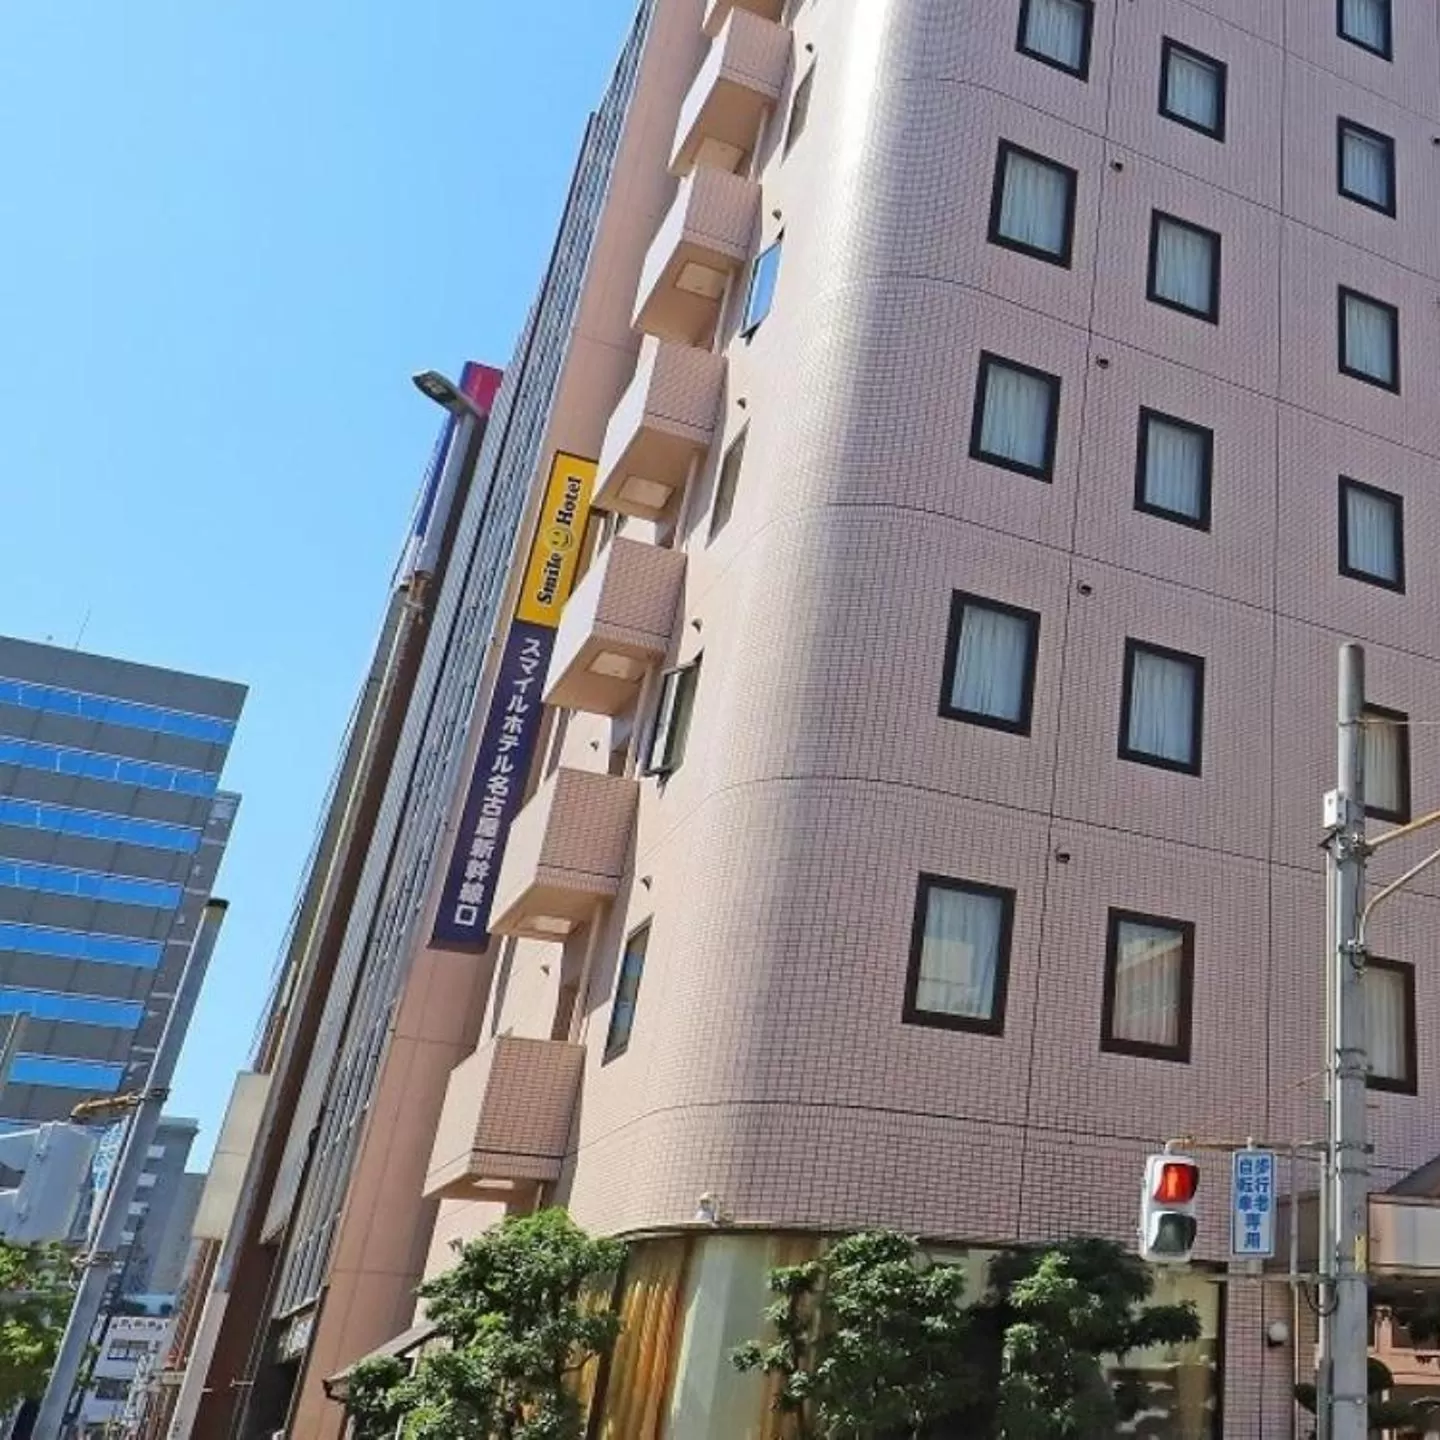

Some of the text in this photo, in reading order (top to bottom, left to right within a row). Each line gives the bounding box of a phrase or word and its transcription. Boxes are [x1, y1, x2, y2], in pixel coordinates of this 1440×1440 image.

[537, 476, 582, 606] Smile Hotel
[454, 637, 541, 927] スマイルホテル名古屋新幹線口
